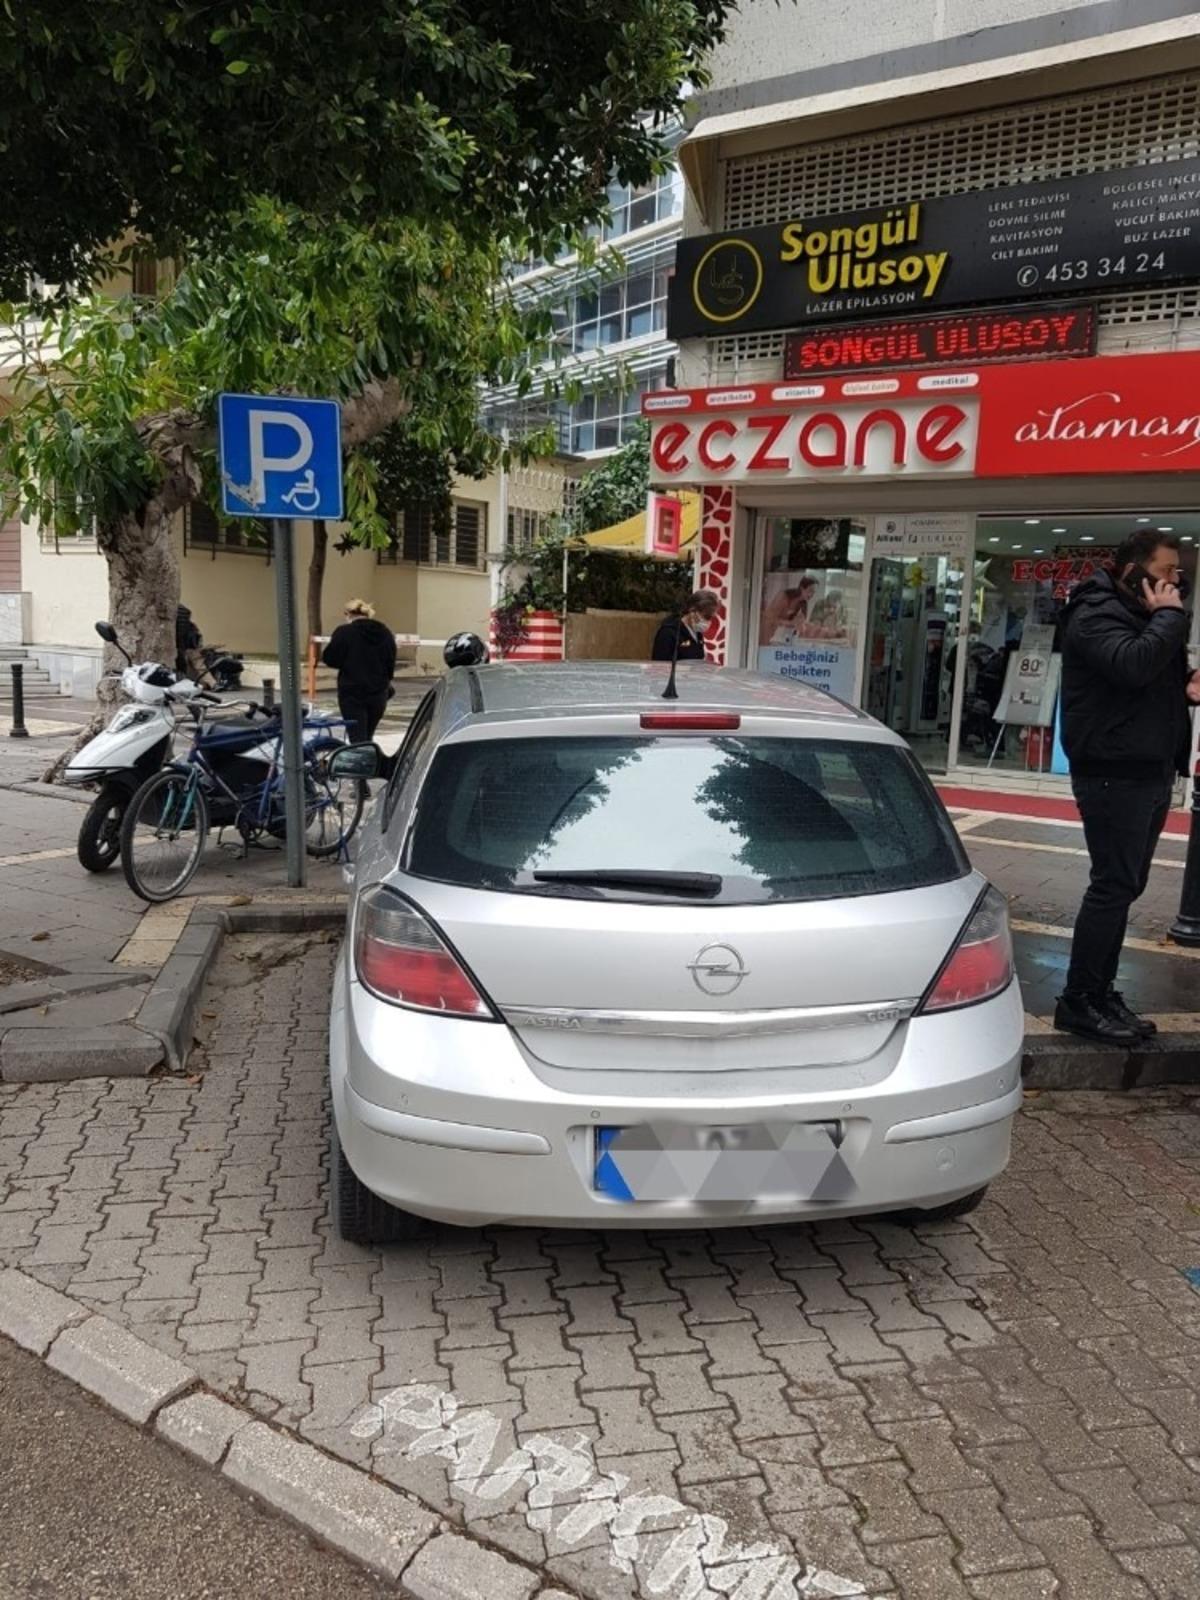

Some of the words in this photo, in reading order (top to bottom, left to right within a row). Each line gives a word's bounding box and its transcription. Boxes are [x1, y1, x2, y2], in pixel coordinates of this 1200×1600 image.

[1112, 196, 1153, 211] KALICI
[781, 202, 920, 262] Songül
[1124, 233, 1149, 244] BUZ
[1153, 227, 1191, 240] LAZER
[808, 251, 948, 297] Ulusoy
[1045, 260, 1089, 282] 453
[1097, 256, 1126, 277] 34
[1136, 252, 1165, 273] 24
[805, 300, 842, 314] LAZER
[936, 315, 1076, 355] ULUSOY
[249, 409, 314, 504] P
[652, 403, 969, 475] eczane
[525, 1015, 582, 1029] ASTRA
